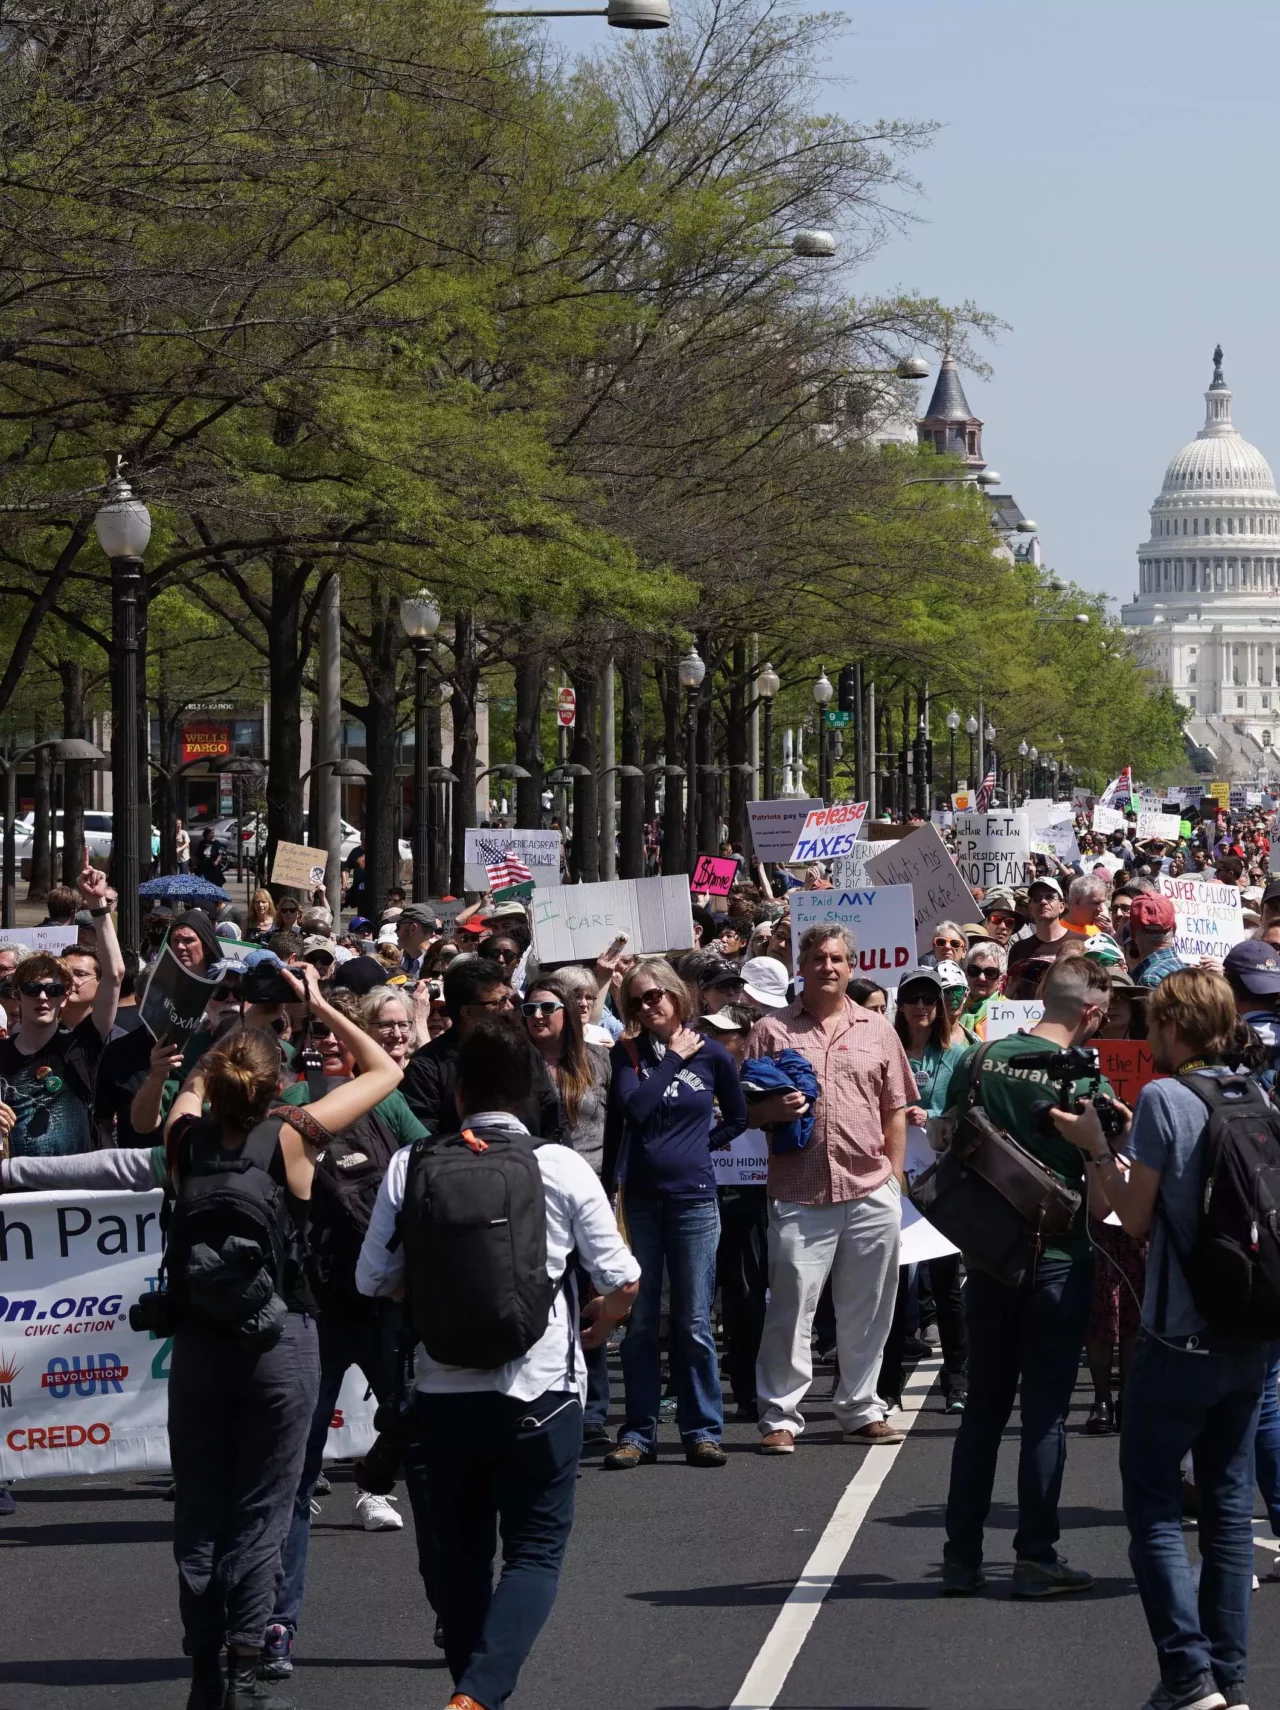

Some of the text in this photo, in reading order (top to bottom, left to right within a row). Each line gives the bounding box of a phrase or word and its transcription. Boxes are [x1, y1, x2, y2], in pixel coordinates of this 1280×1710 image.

[829, 712, 836, 721] 9
[185, 733, 228, 743] WELLS
[186, 743, 228, 753] FARGO
[805, 802, 866, 828] release
[796, 834, 856, 860] TAXES
[523, 853, 556, 866] TRUMP
[845, 861, 861, 878] BIG
[876, 846, 942, 886] What's his
[961, 861, 1028, 886] NO PLAN
[798, 891, 876, 906] I Paid MY
[914, 873, 960, 926] ax Rate?
[1164, 880, 1237, 907] SUPER CALLOUS
[536, 901, 615, 931] I CARE
[798, 911, 861, 923] Fair Share
[1207, 907, 1238, 922] RACIST
[1187, 917, 1219, 936] EXTRA
[1173, 936, 1233, 958] RAGGADOCIO
[853, 946, 909, 972] ULD
[162, 998, 202, 1032] #TaxM
[990, 1005, 1044, 1021] I'm Yo
[1106, 1053, 1132, 1073] the
[713, 1157, 769, 1168] YOU HIDIN
[57, 1206, 166, 1257] Par
[25, 1320, 114, 1336] CIVIC ACTION
[47, 1368, 122, 1383] REVOLUTION
[47, 1353, 124, 1399] OUR
[7, 1422, 110, 1451] CREDO
